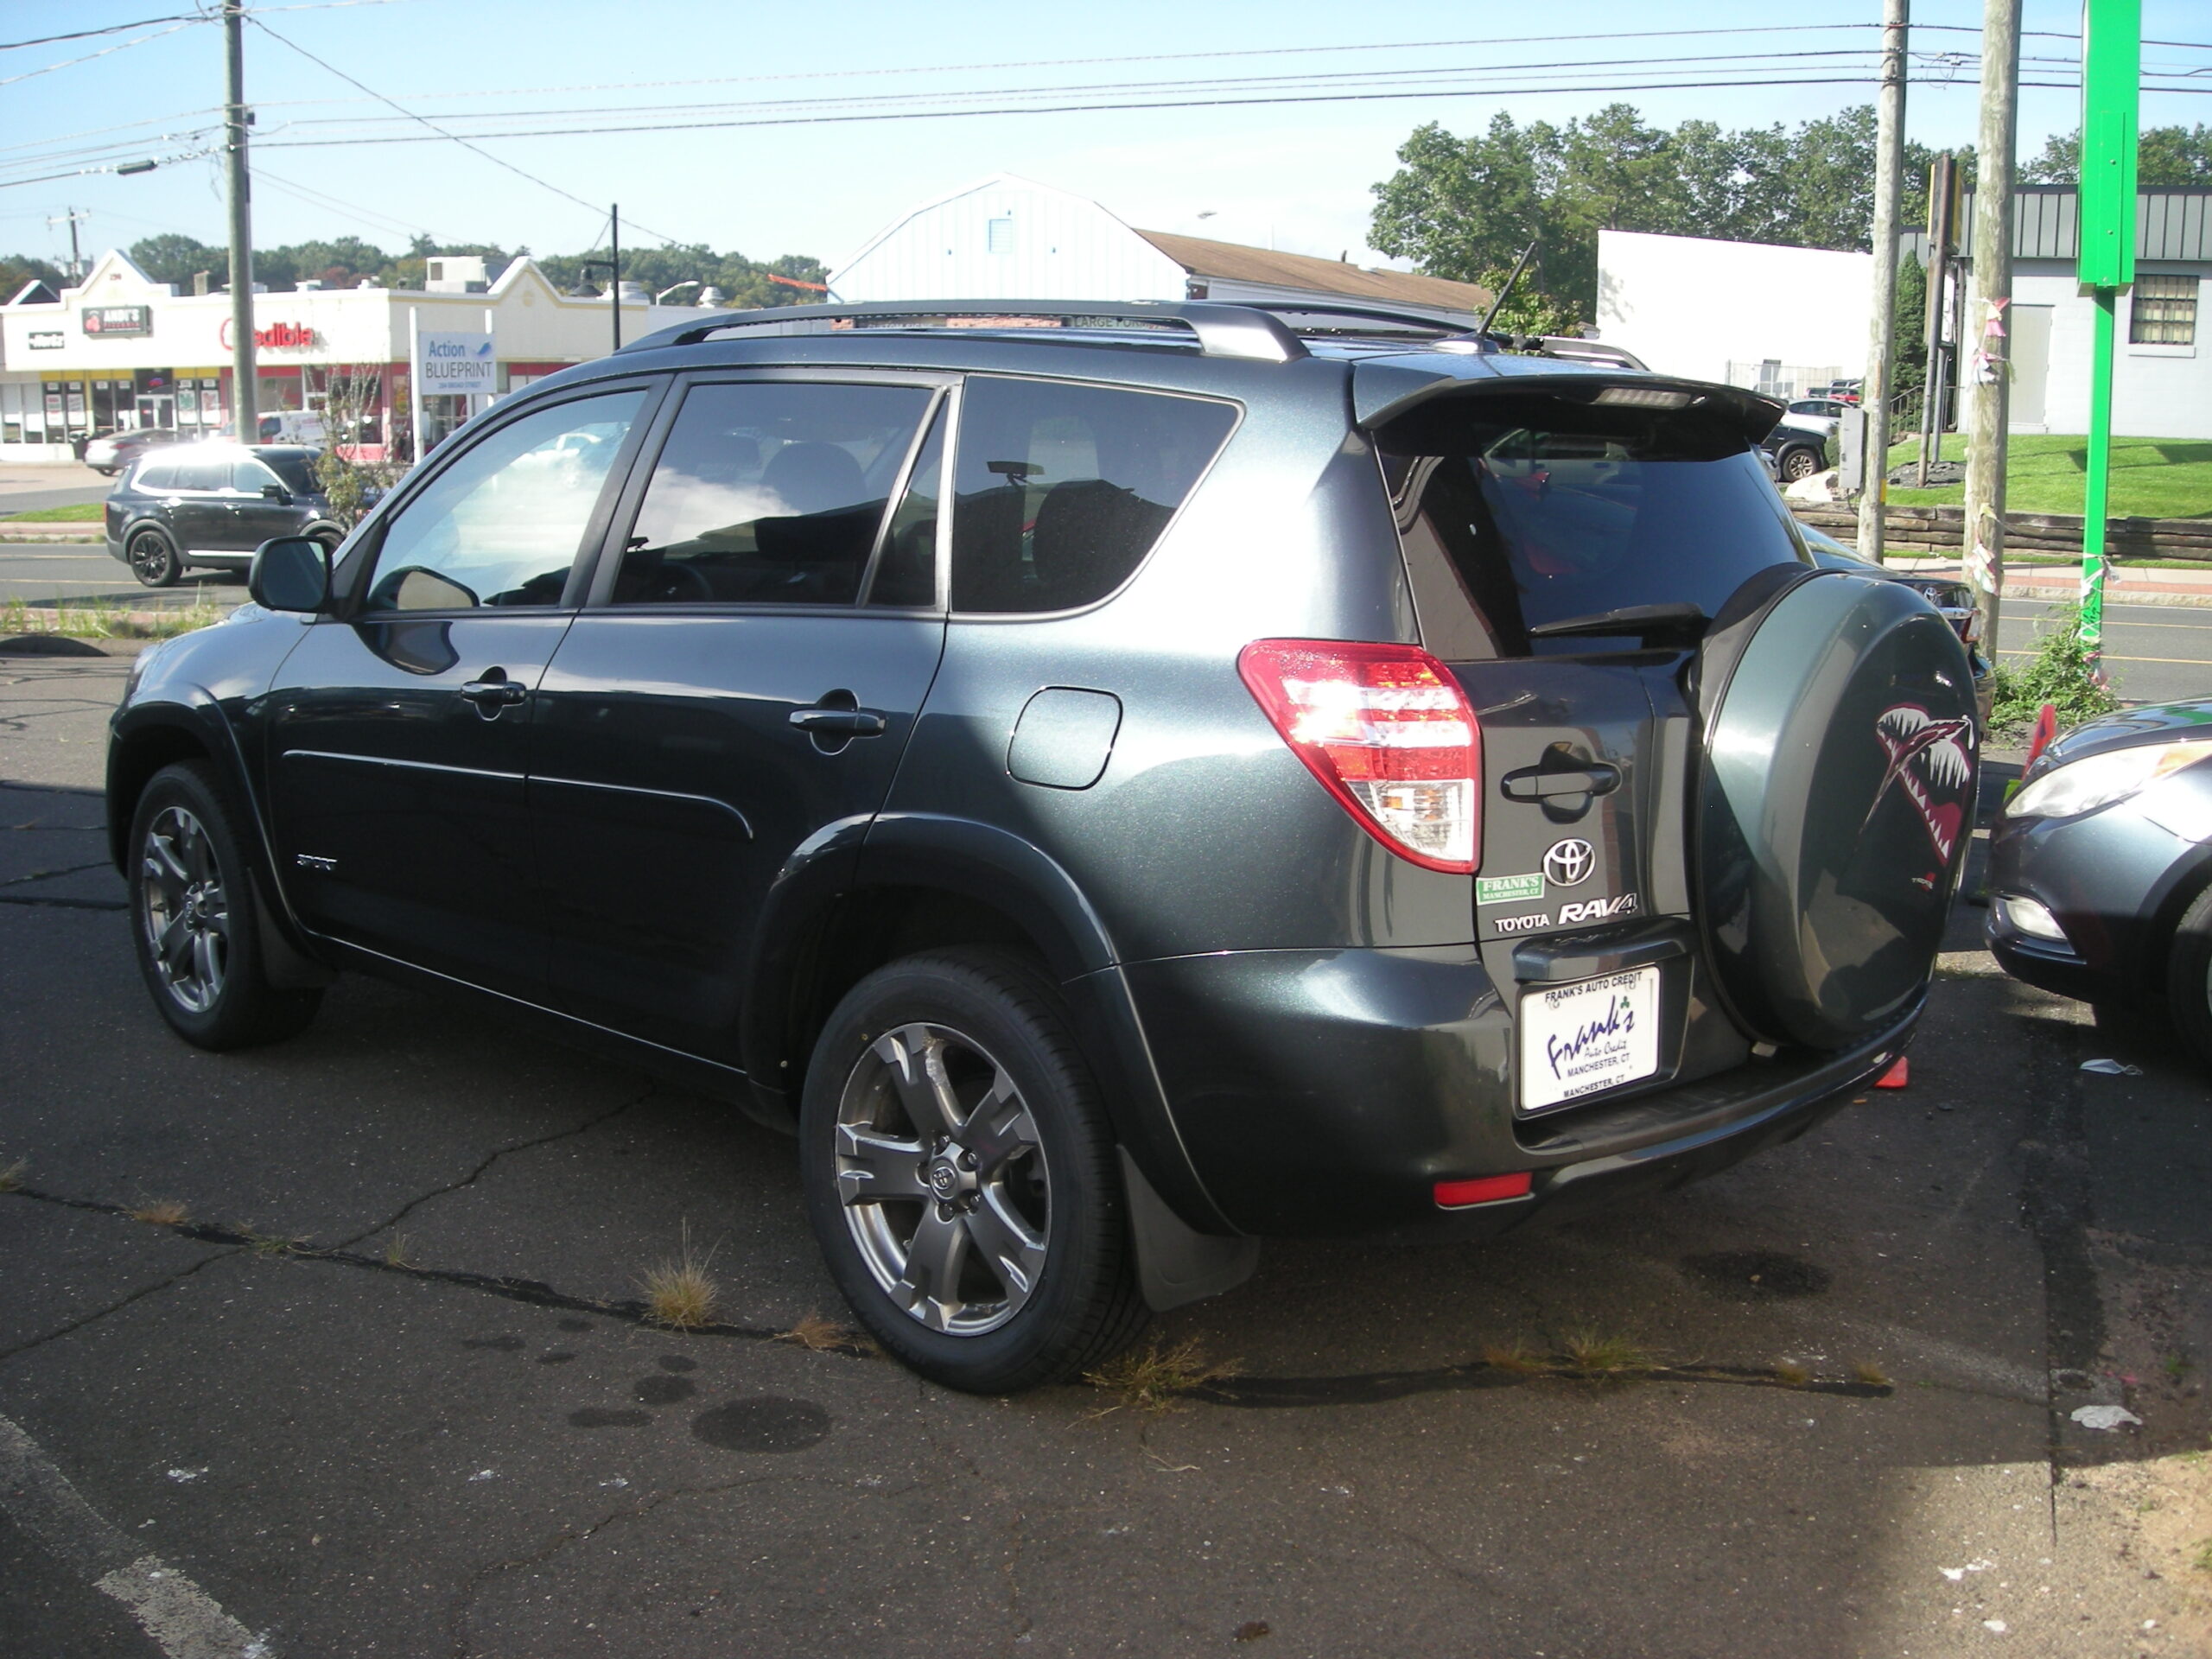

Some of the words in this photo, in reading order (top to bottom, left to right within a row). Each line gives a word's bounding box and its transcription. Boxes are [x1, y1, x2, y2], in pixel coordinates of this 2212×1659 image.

[104, 308, 139, 322] ANDI'S
[1074, 316, 1114, 327] LARGE
[429, 340, 466, 358] Action
[425, 361, 493, 378] BLUEPRINT
[1483, 876, 1540, 893] FRANK'S
[1496, 914, 1550, 933] TOYOTA
[1558, 893, 1637, 925] RAV4
[1545, 984, 1583, 1003] FRANK'S
[1586, 979, 1610, 994] AUTO
[1612, 971, 1643, 987] CREDIT
[1584, 1047, 1601, 1058] Auto
[1604, 1039, 1627, 1055] Credit
[1620, 1053, 1630, 1064] CT
[1615, 1074, 1625, 1084] CT
